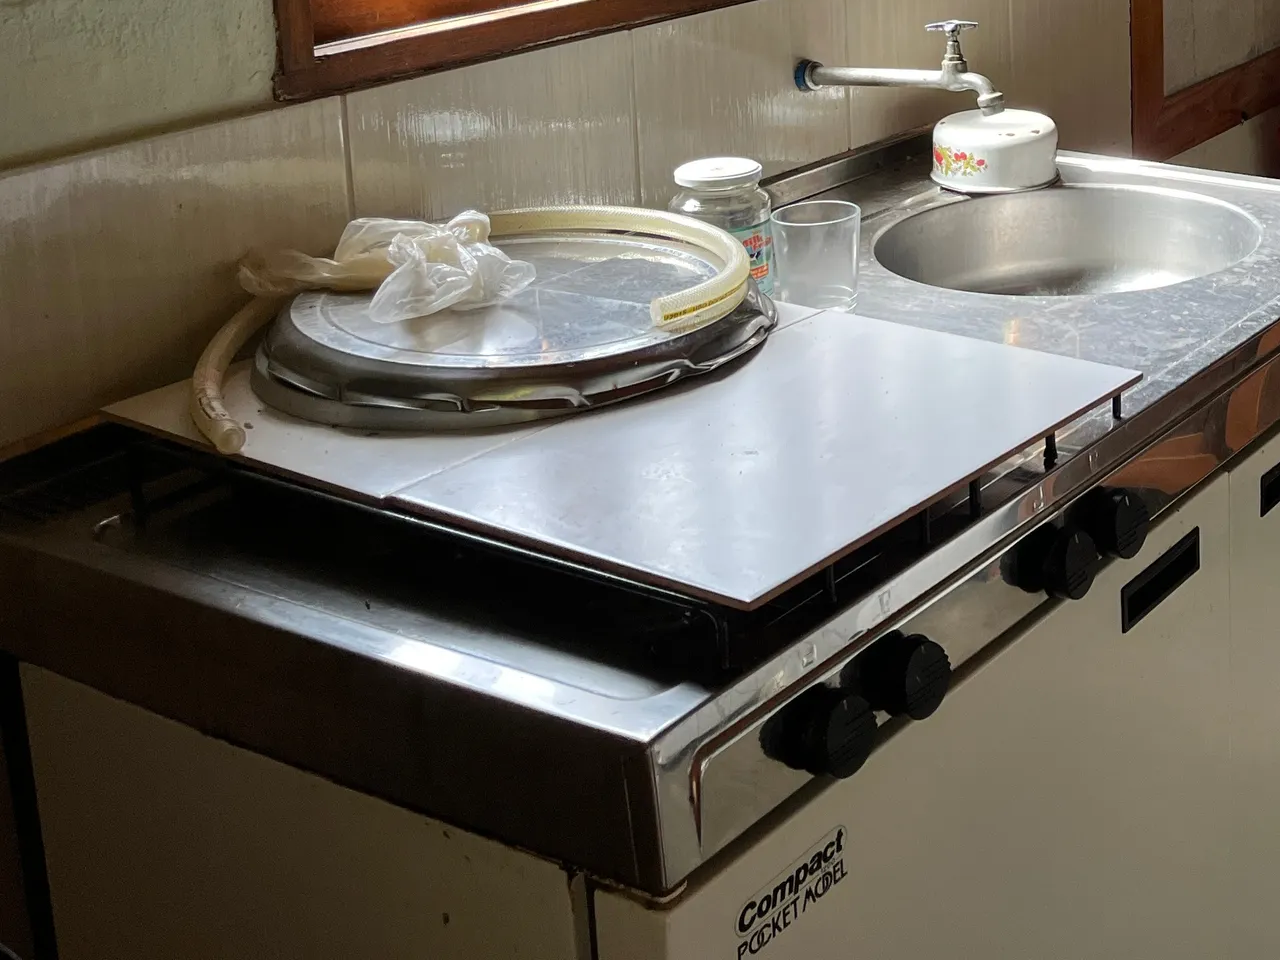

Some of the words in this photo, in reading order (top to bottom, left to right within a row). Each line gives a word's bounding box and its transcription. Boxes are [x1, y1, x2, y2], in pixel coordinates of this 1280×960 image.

[737, 895, 800, 960] POCKET
[802, 858, 848, 913] MODEL
[738, 828, 844, 933] Compact
